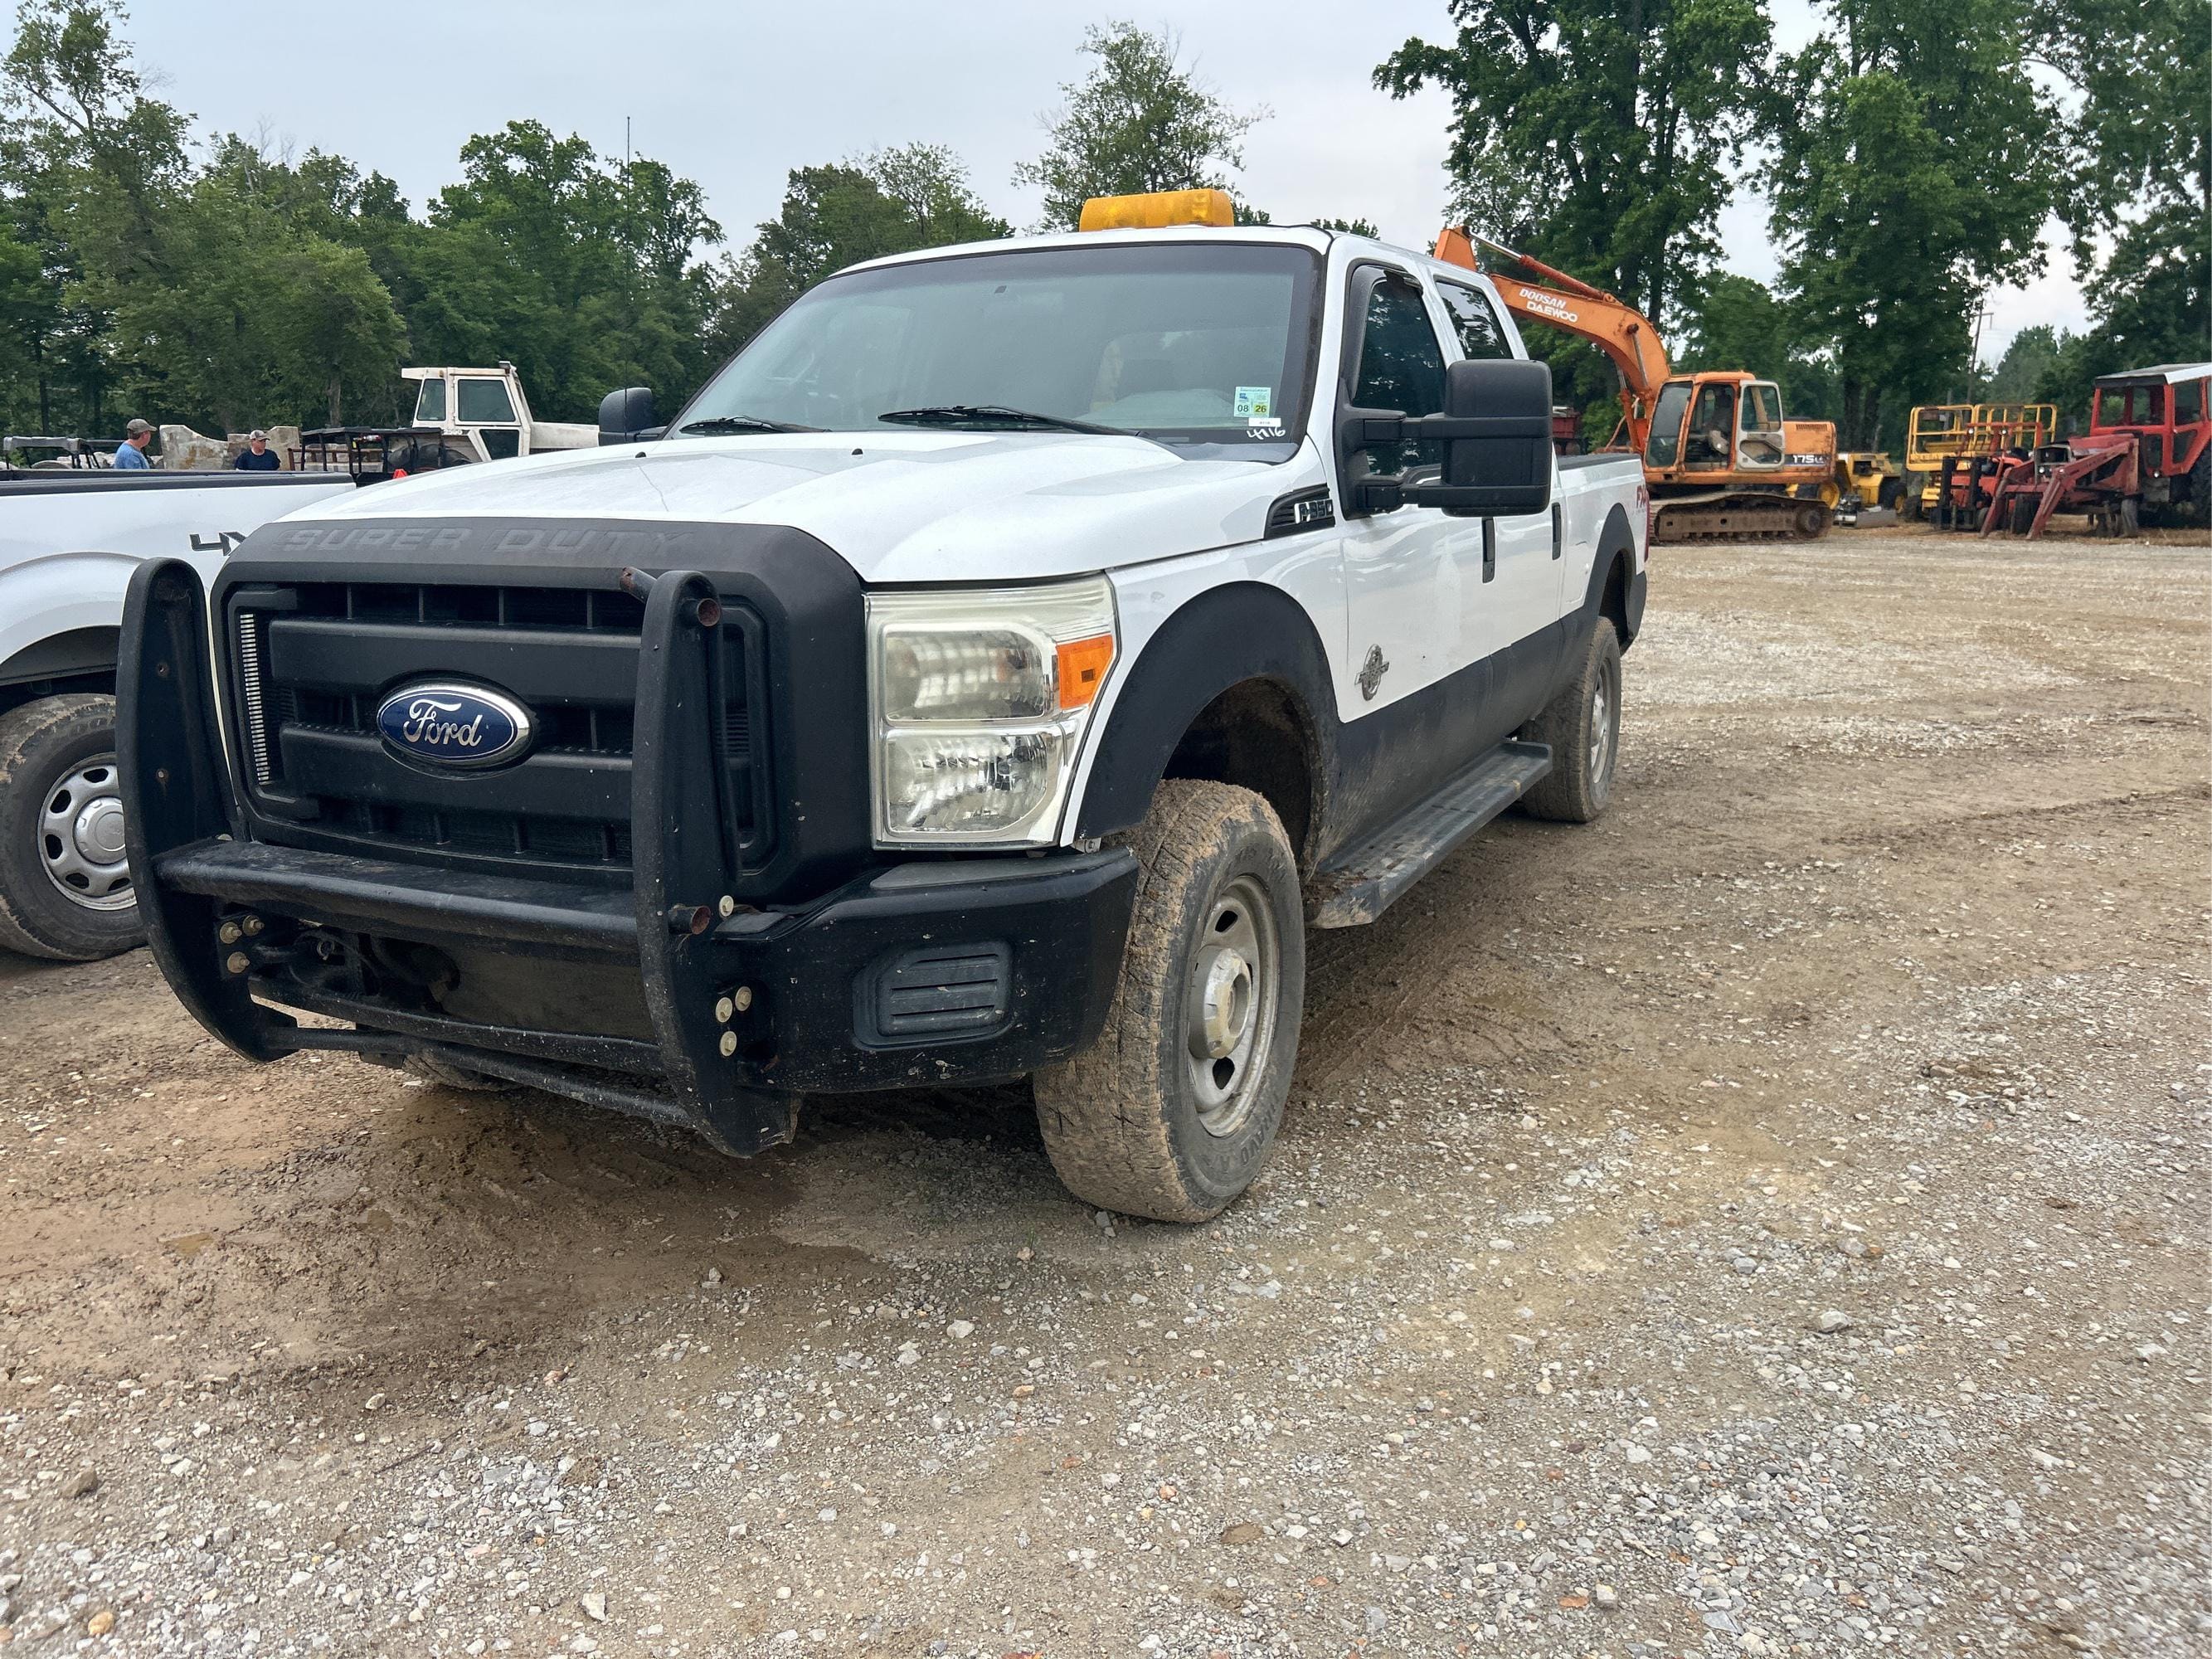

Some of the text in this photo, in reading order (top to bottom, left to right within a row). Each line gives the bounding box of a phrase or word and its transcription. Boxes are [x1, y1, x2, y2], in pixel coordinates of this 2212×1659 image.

[1519, 288, 1566, 309] DOOSAN
[1527, 300, 1578, 323] DAEWOO
[1237, 404, 1267, 413] 08 26
[272, 527, 698, 553] SUPER DUTY
[403, 698, 484, 747] Ford
